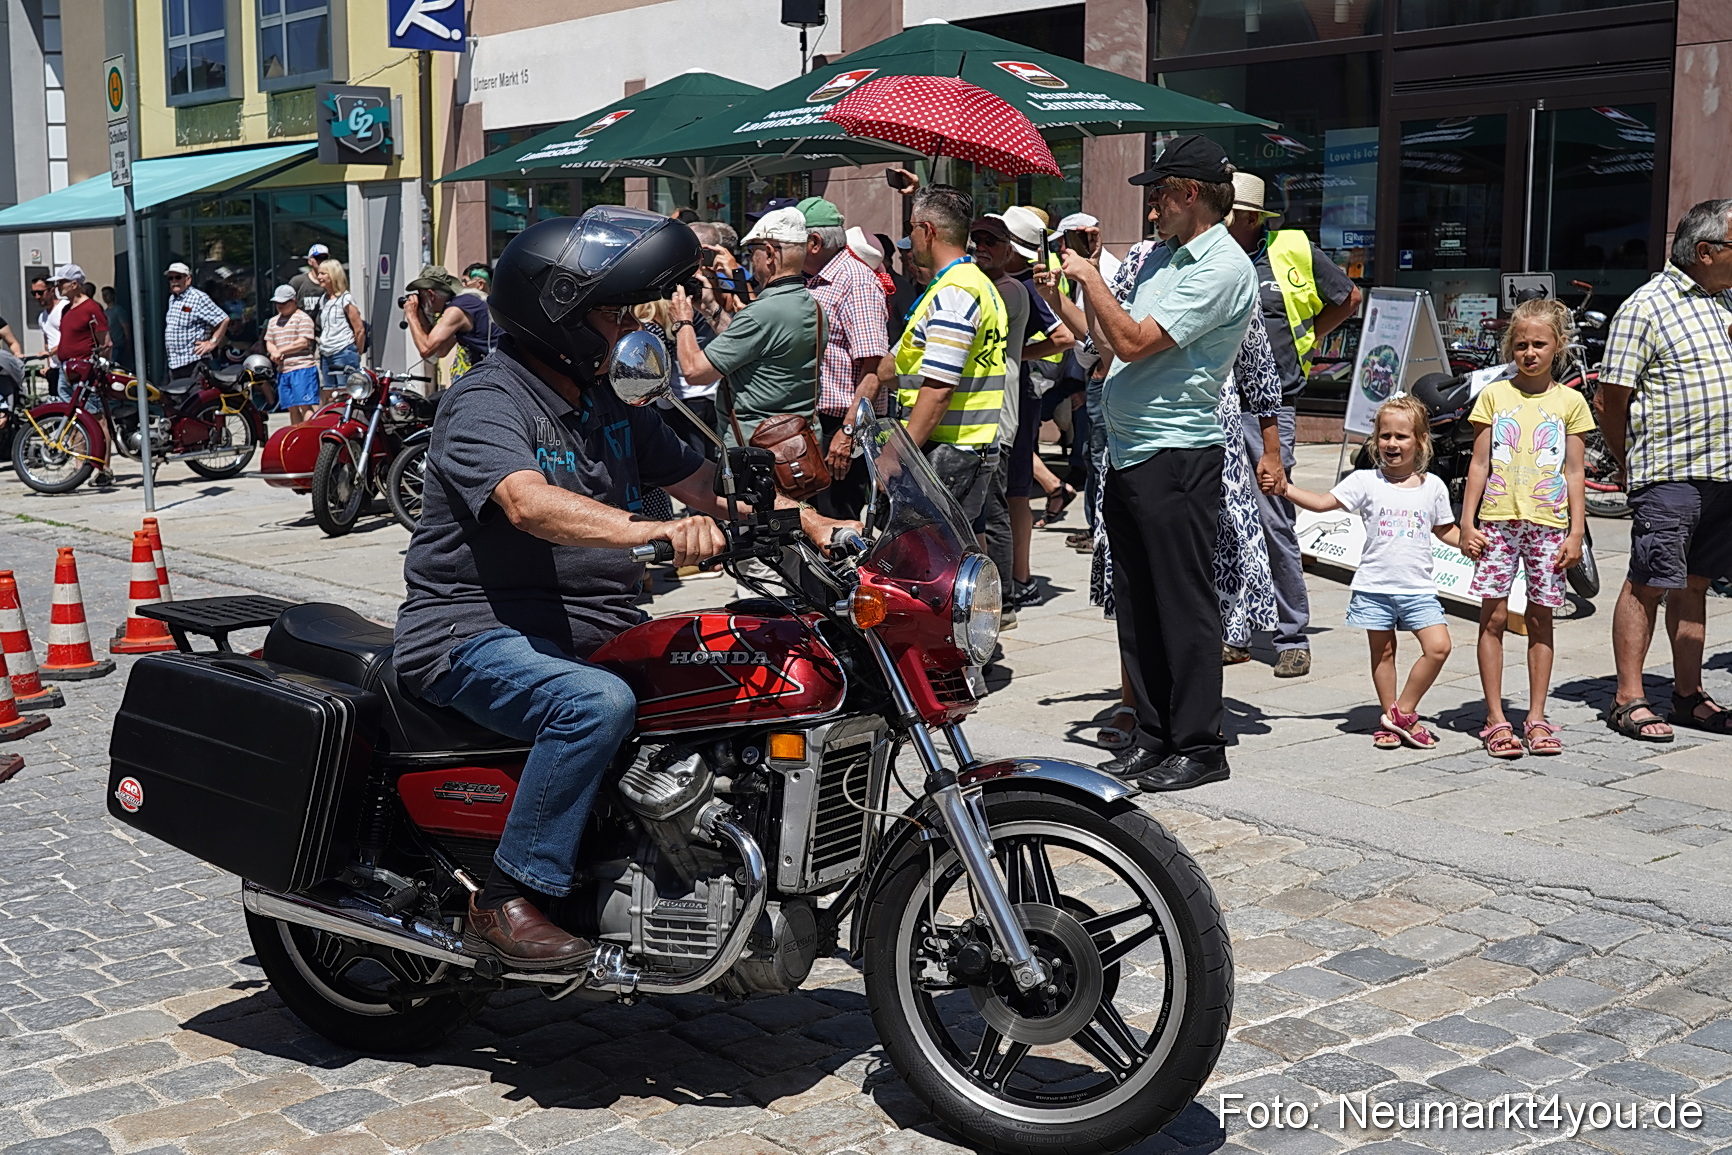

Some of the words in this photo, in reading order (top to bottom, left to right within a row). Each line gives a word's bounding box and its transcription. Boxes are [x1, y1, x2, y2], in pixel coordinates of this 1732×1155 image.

[473, 75, 498, 92] Unterer
[499, 72, 519, 88] Markt
[520, 69, 530, 84] 15
[763, 103, 834, 119] Neumarkte
[1026, 99, 1145, 111] Lammsbräu
[348, 106, 374, 140] G2
[733, 113, 834, 133] Lammsbr
[1330, 152, 1351, 163] Love
[1354, 149, 1362, 159] is
[1364, 147, 1379, 158] lov
[1353, 231, 1376, 244] Ruppre
[1309, 531, 1347, 557] Express
[1433, 571, 1460, 587] 1958
[669, 650, 771, 665] HONDA
[658, 900, 707, 910] HONDA
